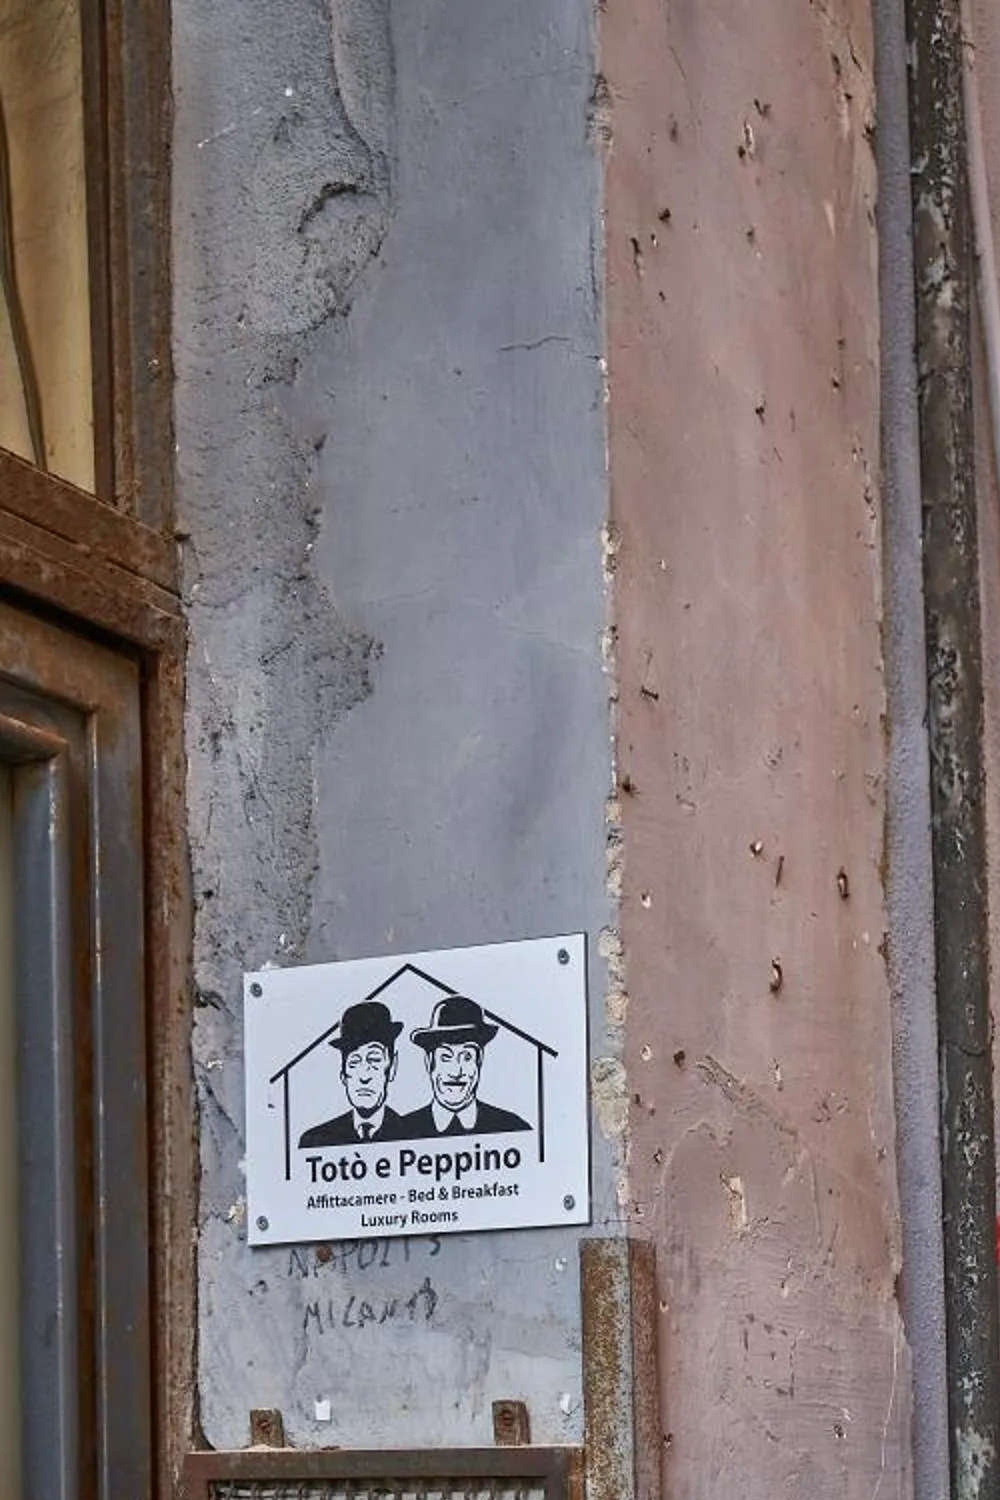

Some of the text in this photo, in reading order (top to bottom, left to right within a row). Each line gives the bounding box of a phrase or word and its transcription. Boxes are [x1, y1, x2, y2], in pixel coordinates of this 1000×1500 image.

[305, 1143, 522, 1183] Totò e Peppino
[306, 1191, 398, 1210] Affittacamere
[408, 1187, 435, 1204] Bed
[437, 1186, 450, 1201] &
[451, 1181, 520, 1200] Breakfast
[360, 1209, 459, 1228] Luxury Rooms
